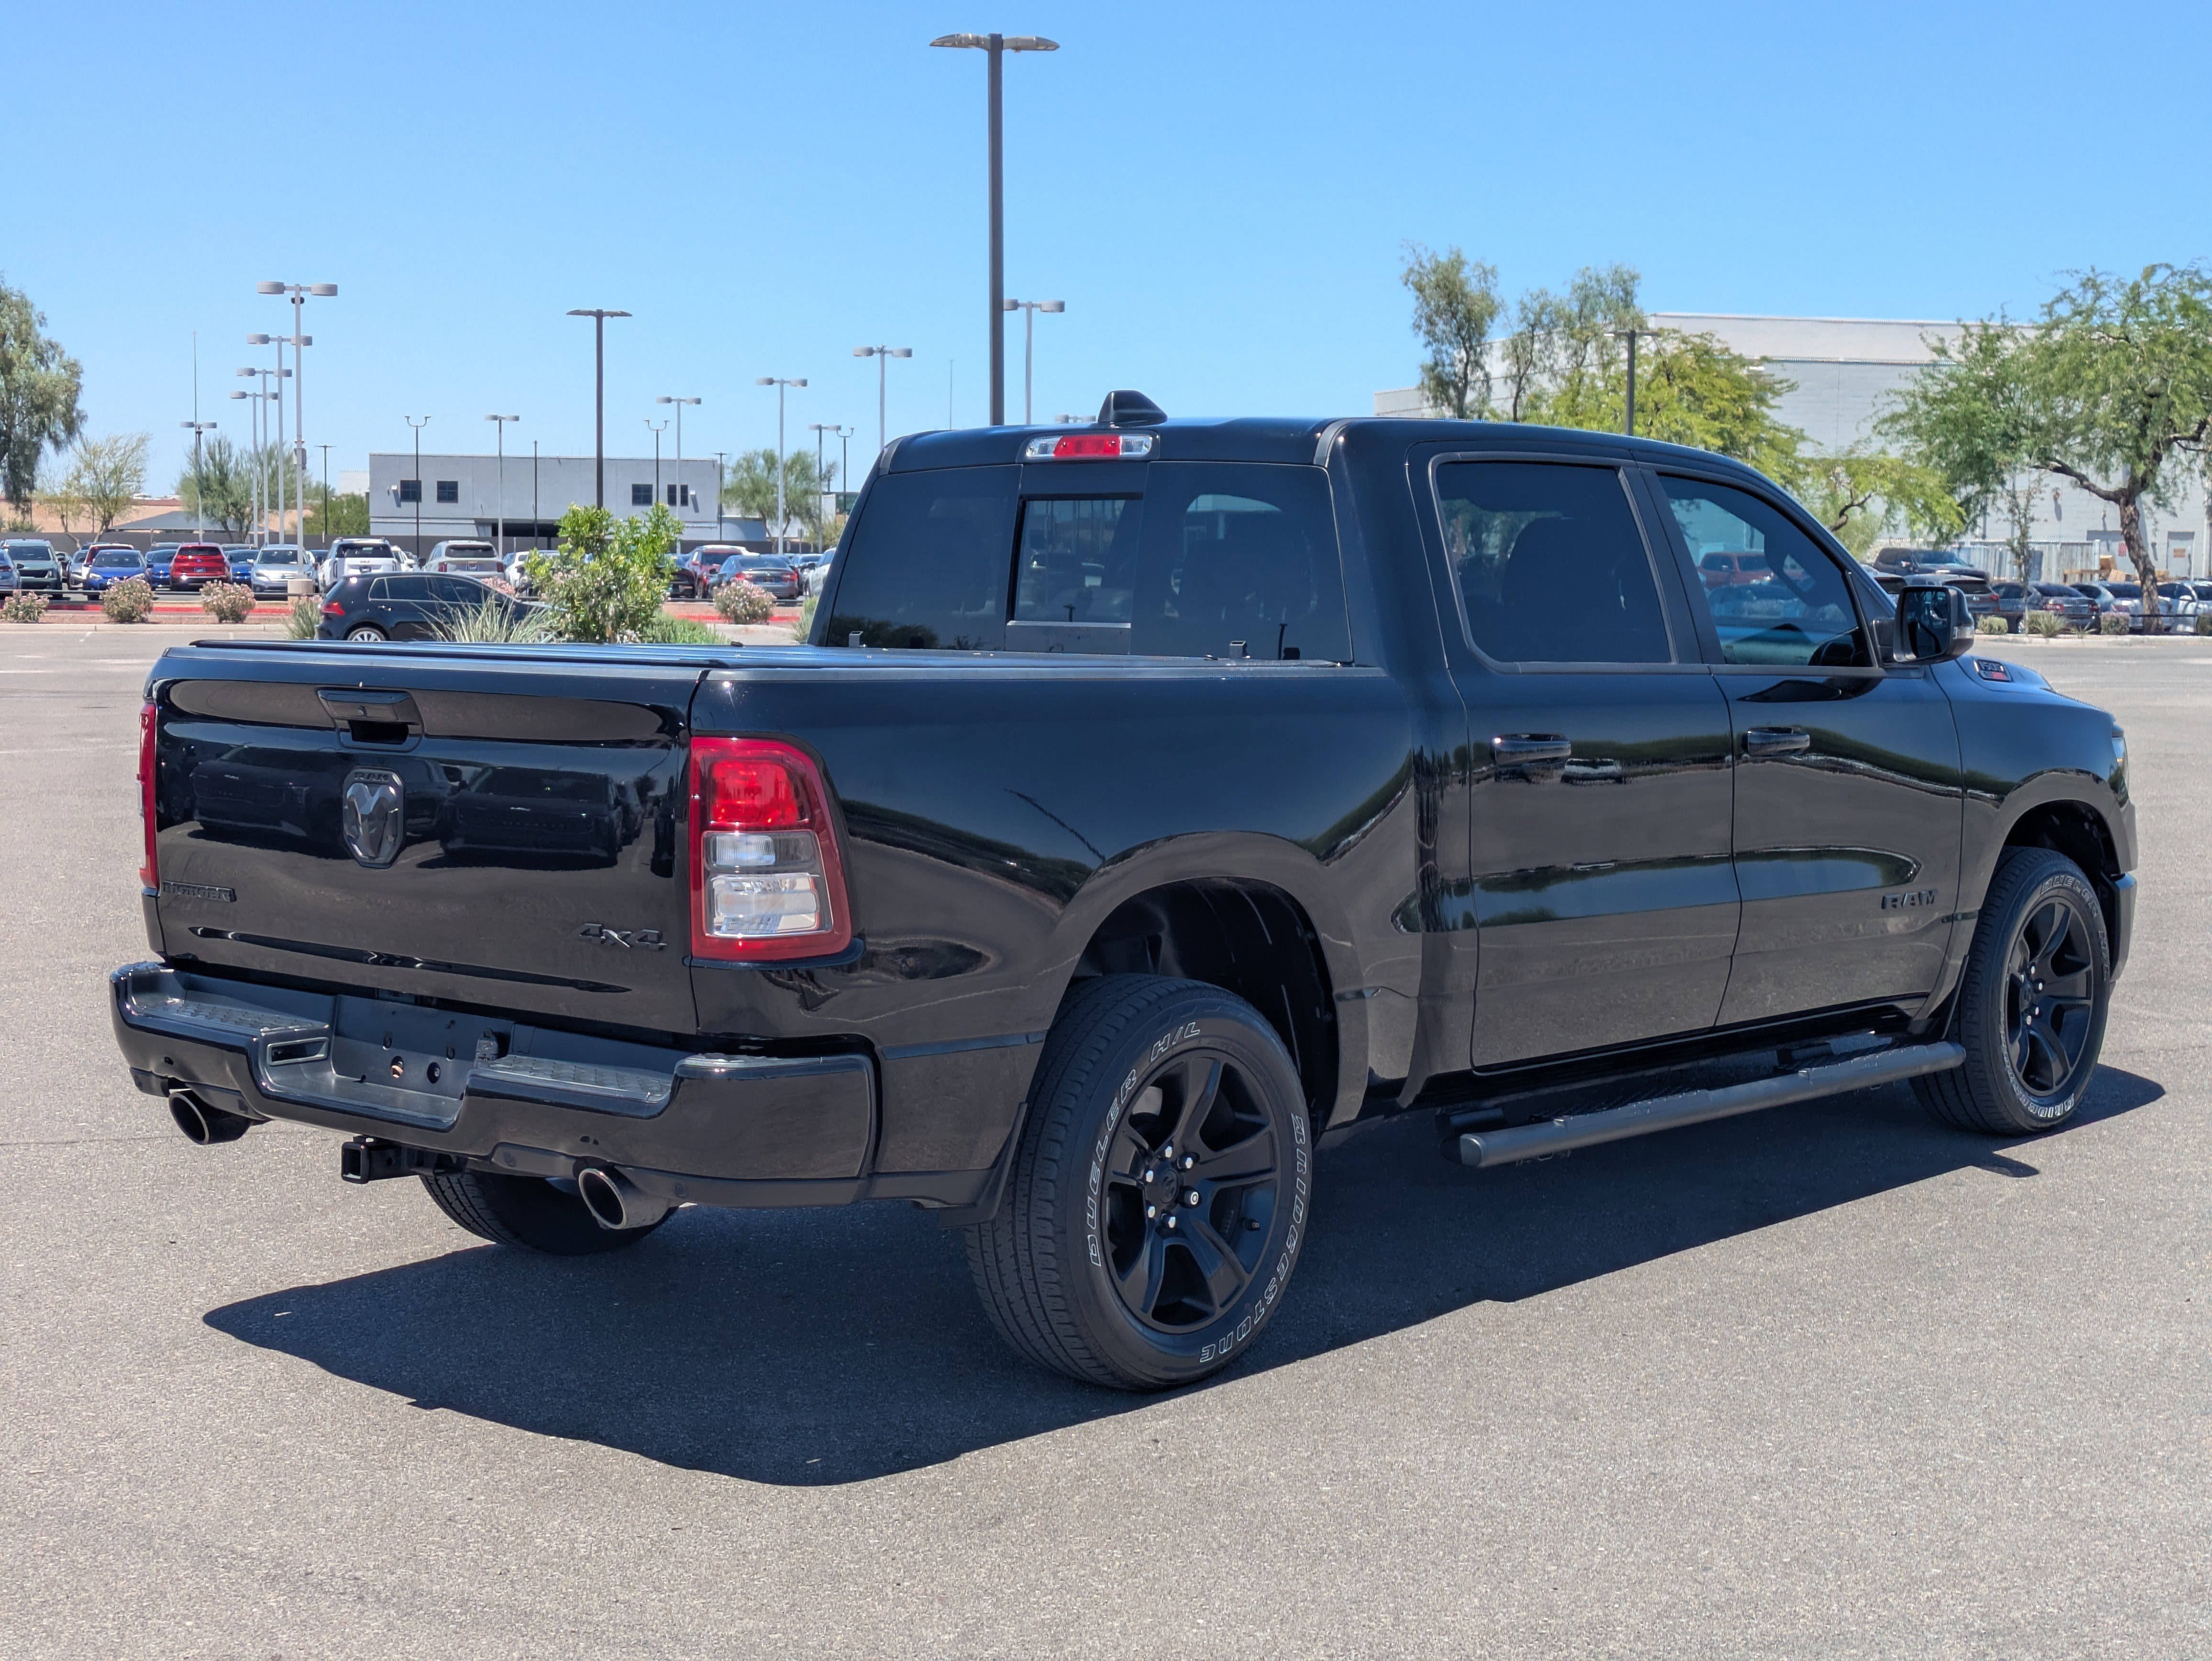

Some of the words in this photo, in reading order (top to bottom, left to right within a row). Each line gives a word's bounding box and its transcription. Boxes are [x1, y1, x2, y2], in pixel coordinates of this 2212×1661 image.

[354, 771, 389, 782] RAM
[1881, 889, 1938, 909] RAM
[2040, 875, 2099, 918] DUELER
[1086, 1069, 1137, 1267] DUELER
[1150, 1021, 1201, 1062] H/L
[1199, 1113, 1306, 1362] BRIDGESTONE
